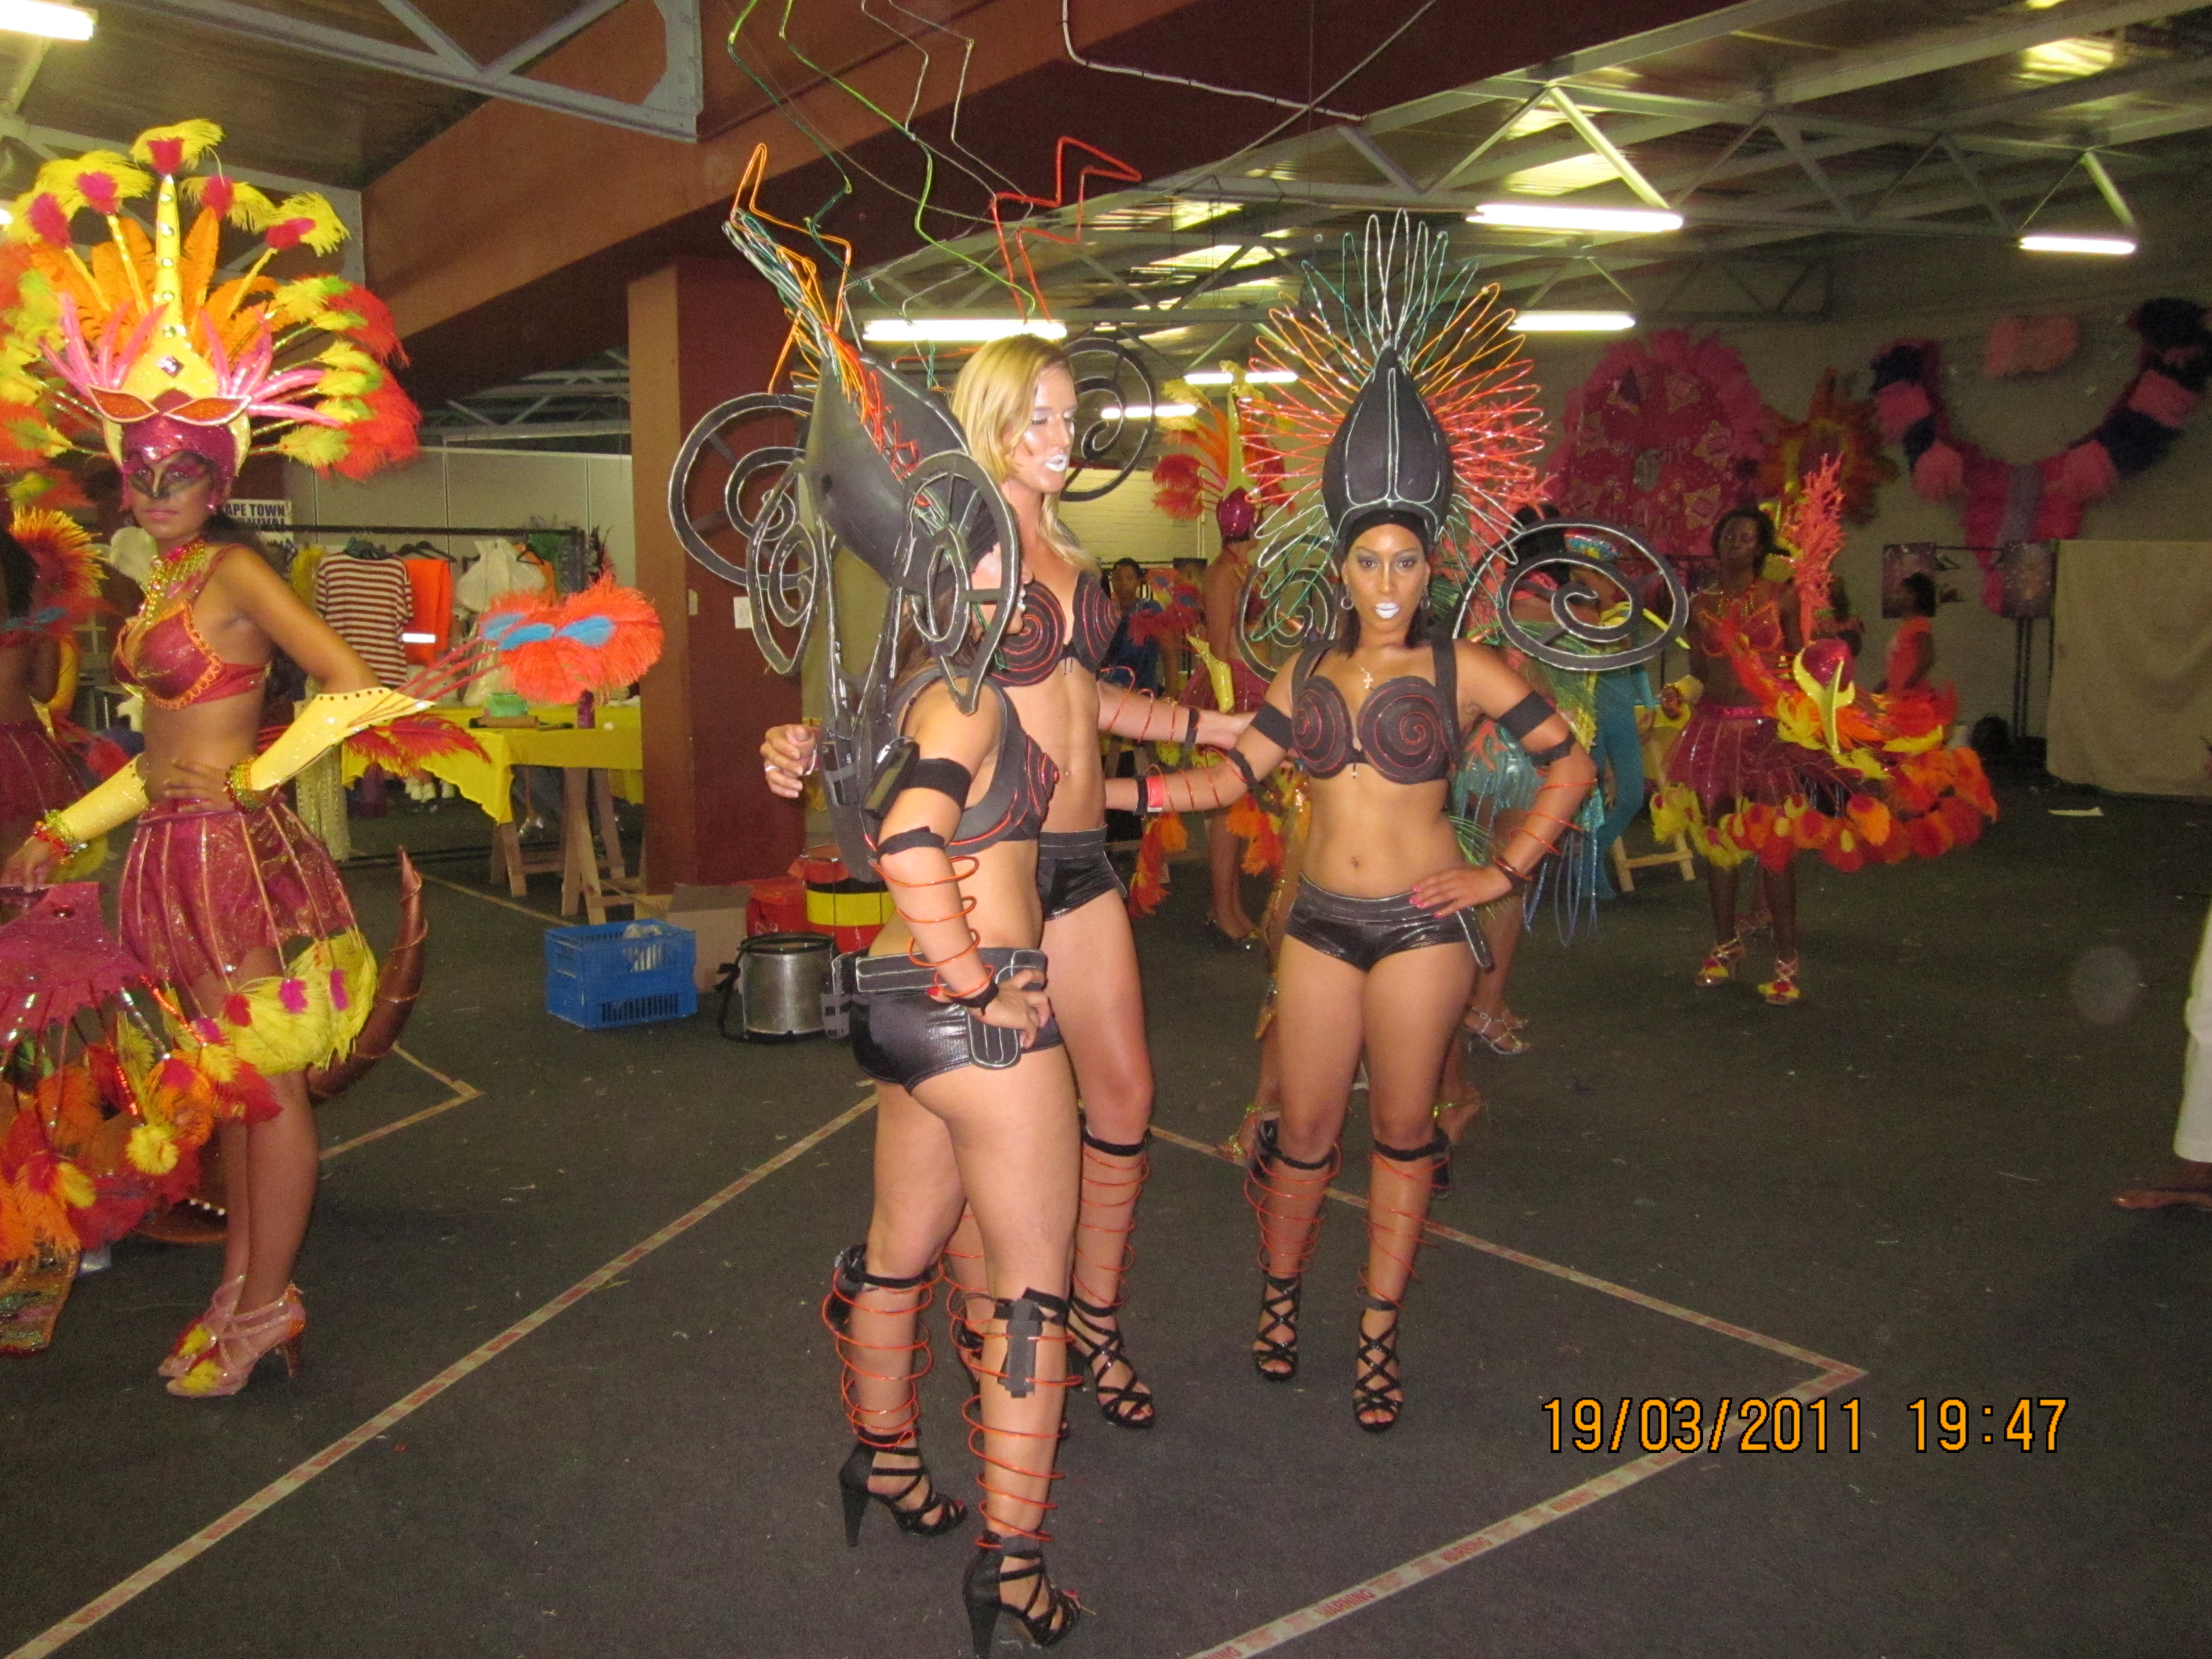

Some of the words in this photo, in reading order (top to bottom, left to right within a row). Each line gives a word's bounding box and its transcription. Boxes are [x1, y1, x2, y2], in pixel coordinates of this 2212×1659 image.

[224, 504, 247, 516] APE
[249, 504, 285, 516] TOWN
[1313, 1589, 1376, 1618] WARNING
